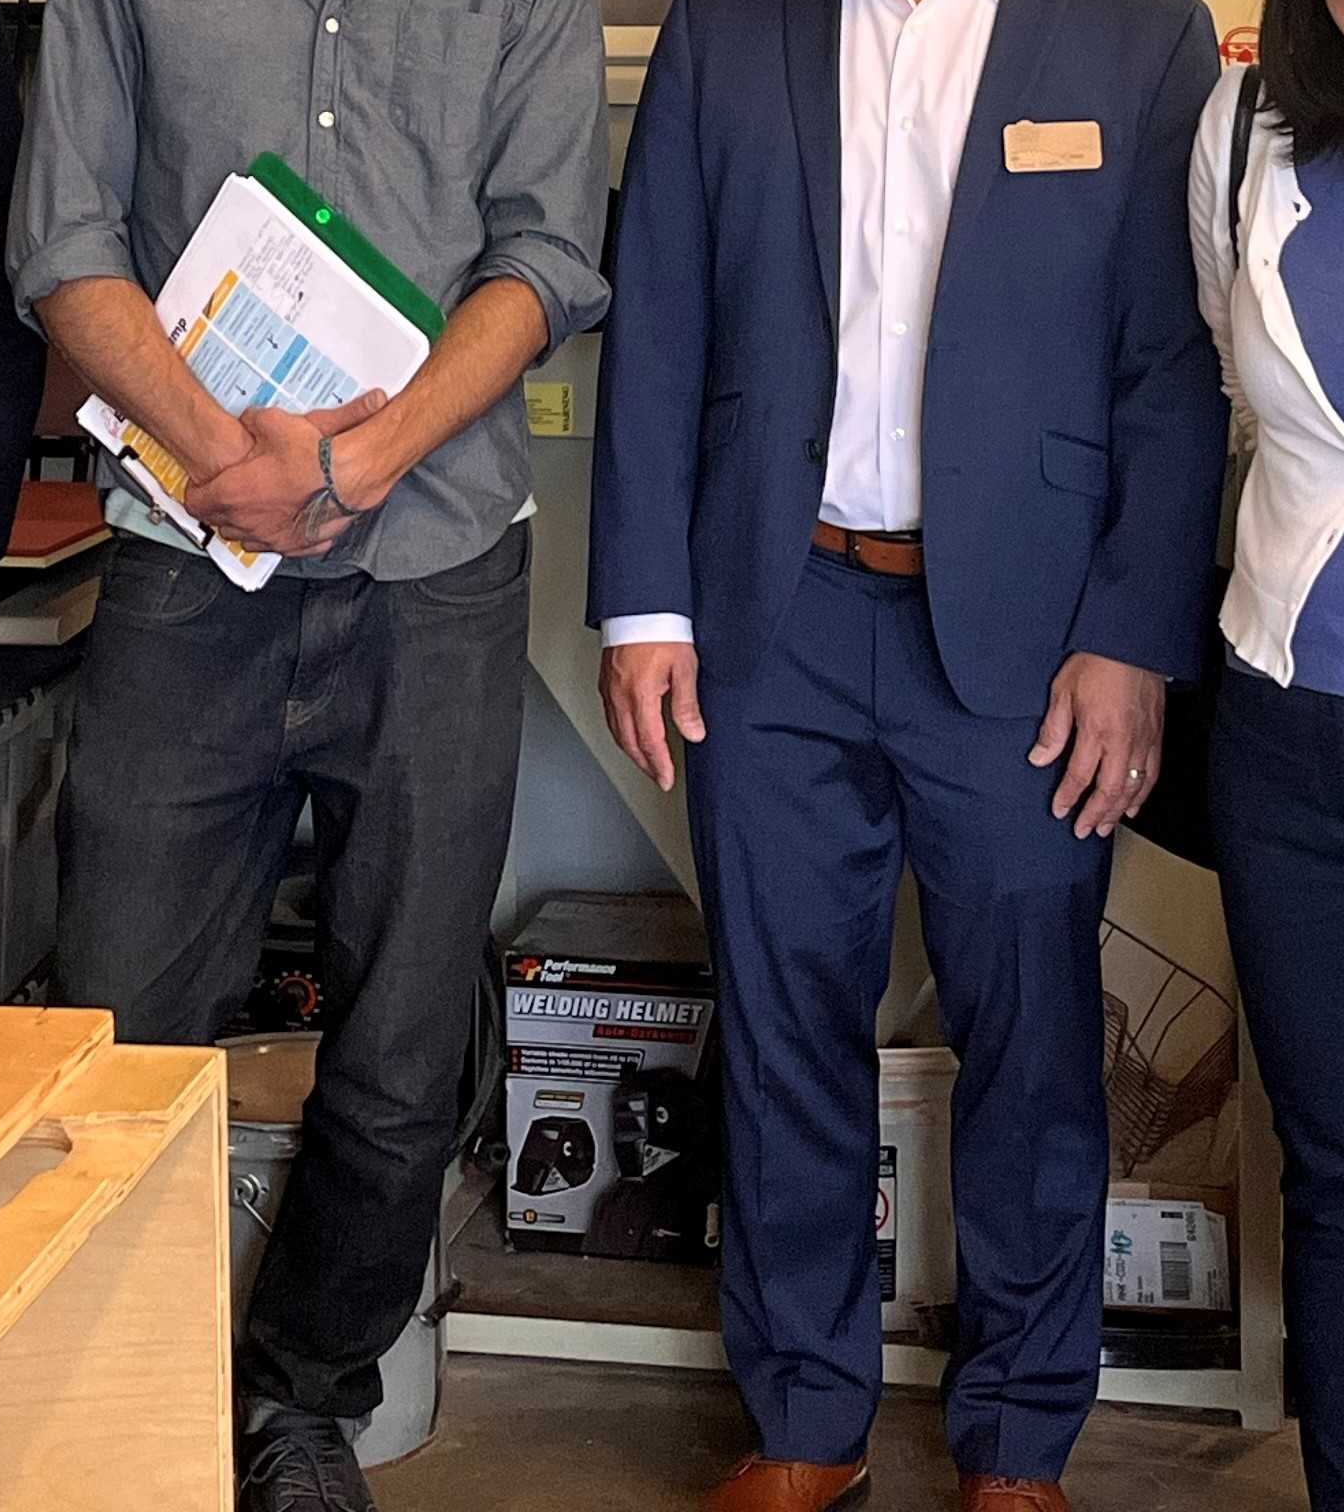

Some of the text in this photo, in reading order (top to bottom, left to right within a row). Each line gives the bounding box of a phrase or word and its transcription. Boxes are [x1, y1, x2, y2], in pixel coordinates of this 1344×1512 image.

[544, 959, 616, 975] Performance
[540, 970, 565, 983] Tool
[512, 992, 703, 1026] WELDING HELMET
